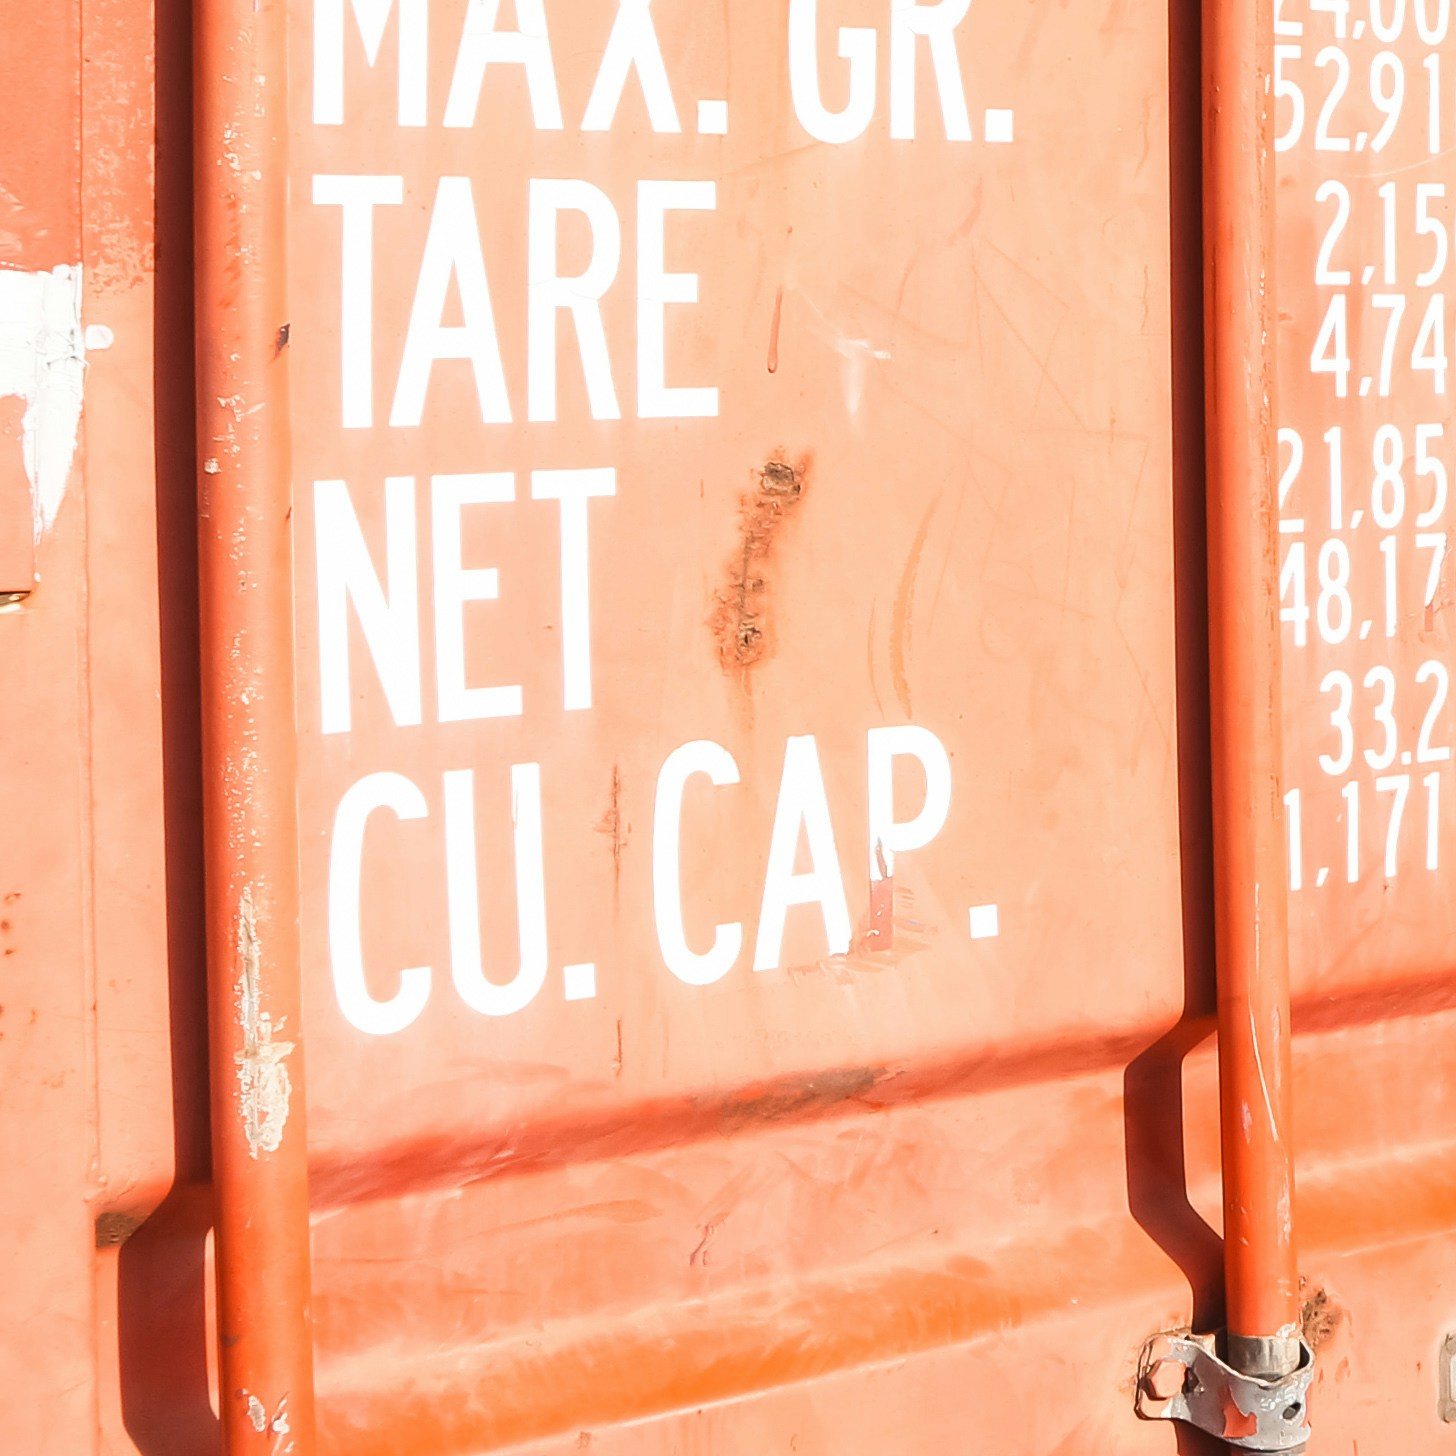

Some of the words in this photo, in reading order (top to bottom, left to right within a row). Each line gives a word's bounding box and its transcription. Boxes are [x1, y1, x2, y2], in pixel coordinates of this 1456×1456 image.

[313, 176, 717, 427] TARE
[315, 469, 615, 733] NET
[1321, 662, 1449, 774] 33.2
[330, 765, 594, 1034] CU.
[654, 727, 997, 984] CAP.
[1286, 774, 1438, 888] 1,171
